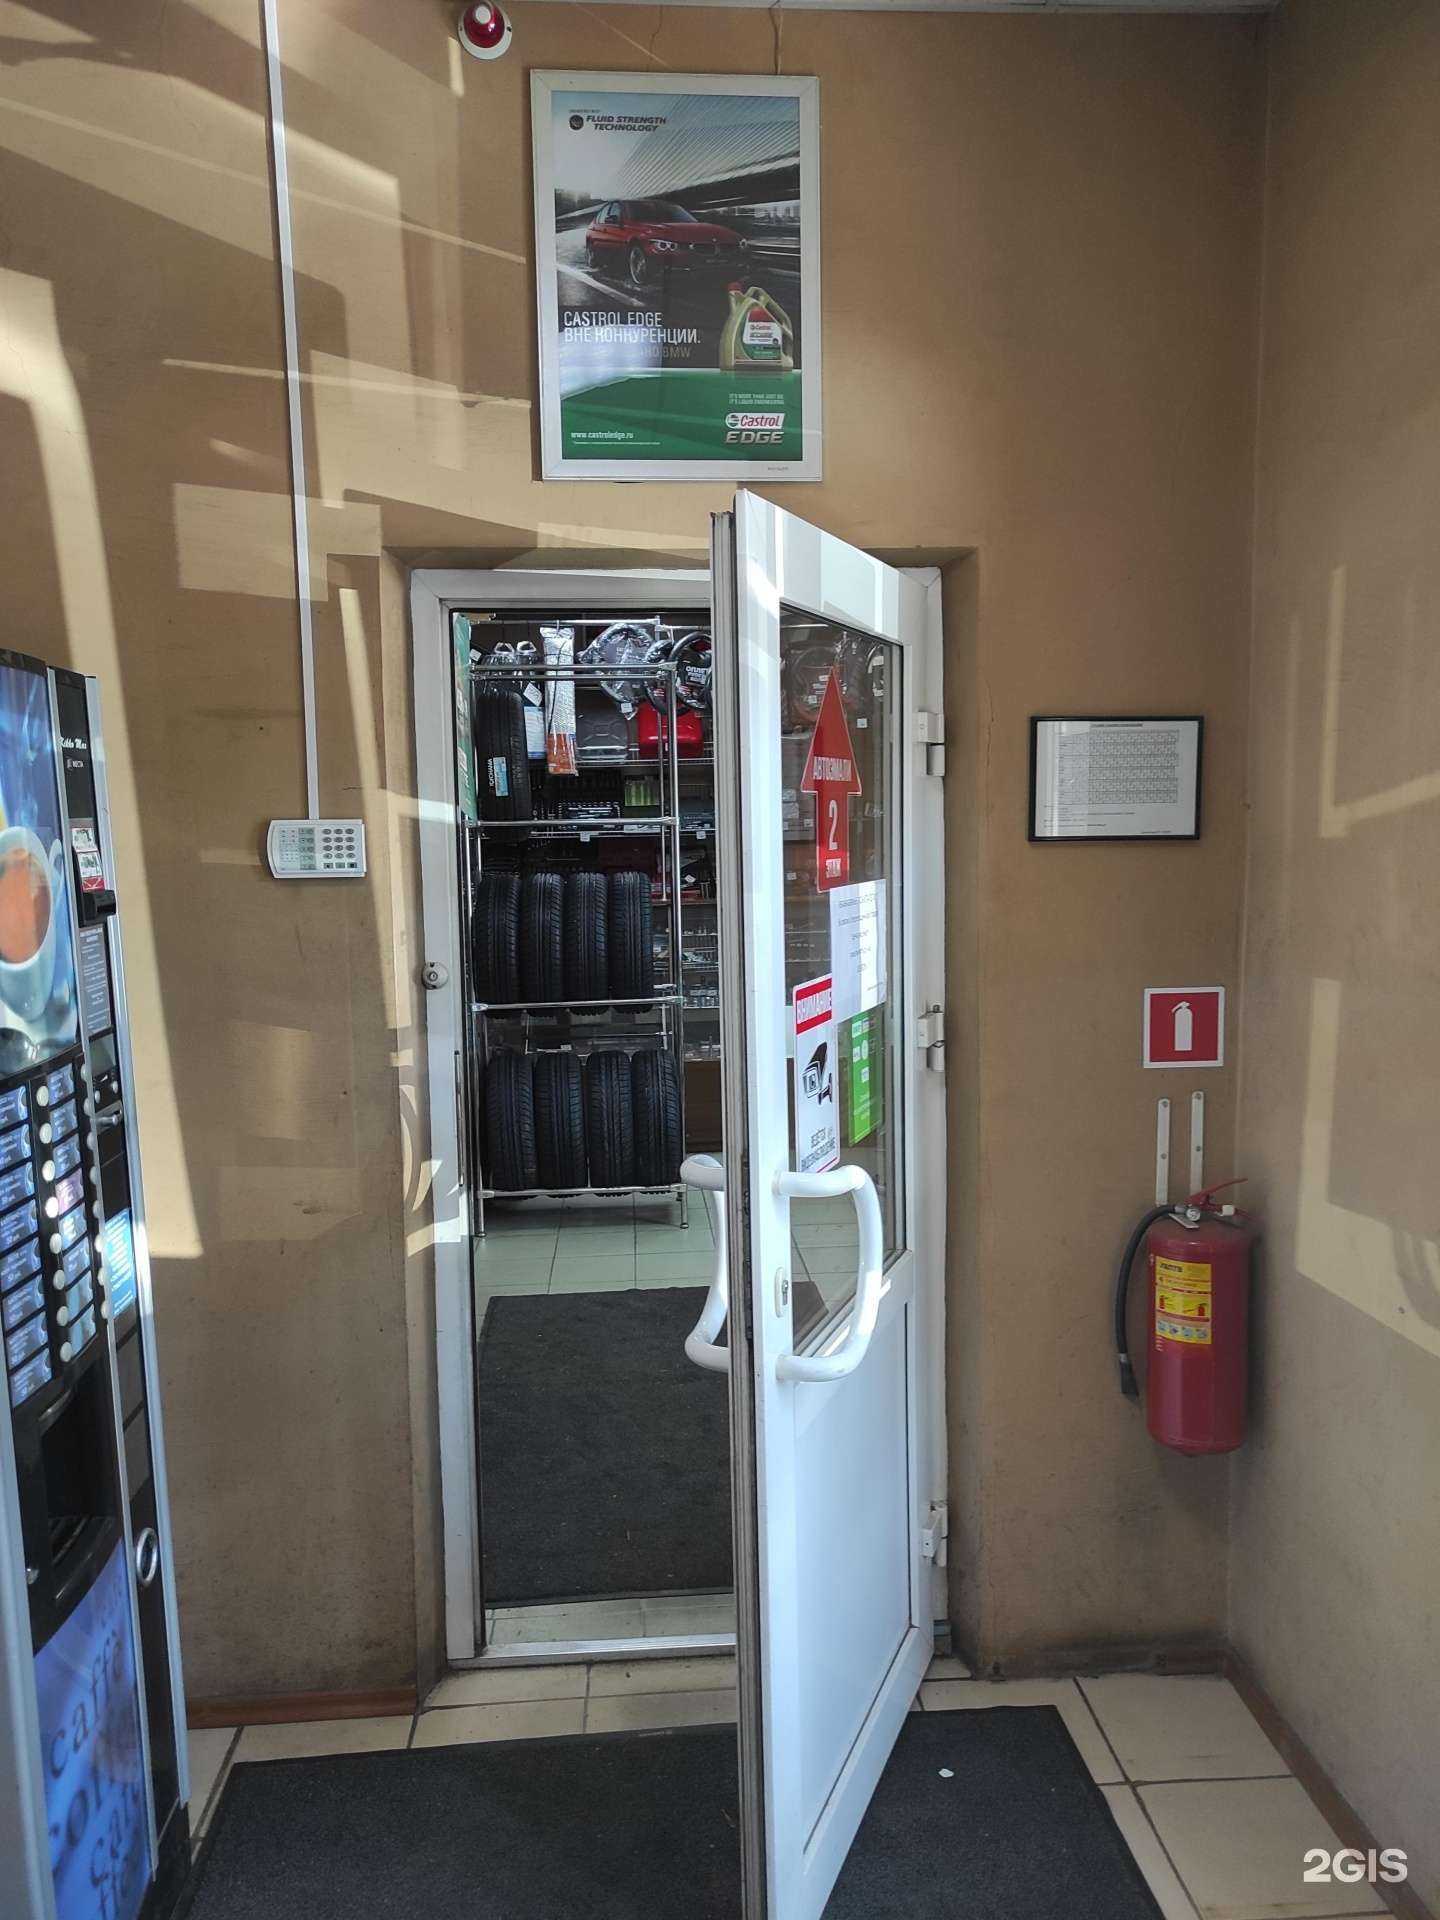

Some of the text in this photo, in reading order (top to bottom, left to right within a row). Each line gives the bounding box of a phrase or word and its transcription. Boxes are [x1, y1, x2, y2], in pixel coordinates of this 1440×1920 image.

[586, 115, 667, 124] FLUID STRENGTH
[594, 123, 660, 132] TECHNOLOGY
[563, 311, 663, 327] CASTROL EDGE
[564, 327, 593, 343] ВНЕ
[740, 414, 781, 427] Castrol
[725, 431, 785, 444] EDGE
[828, 799, 838, 851] 2
